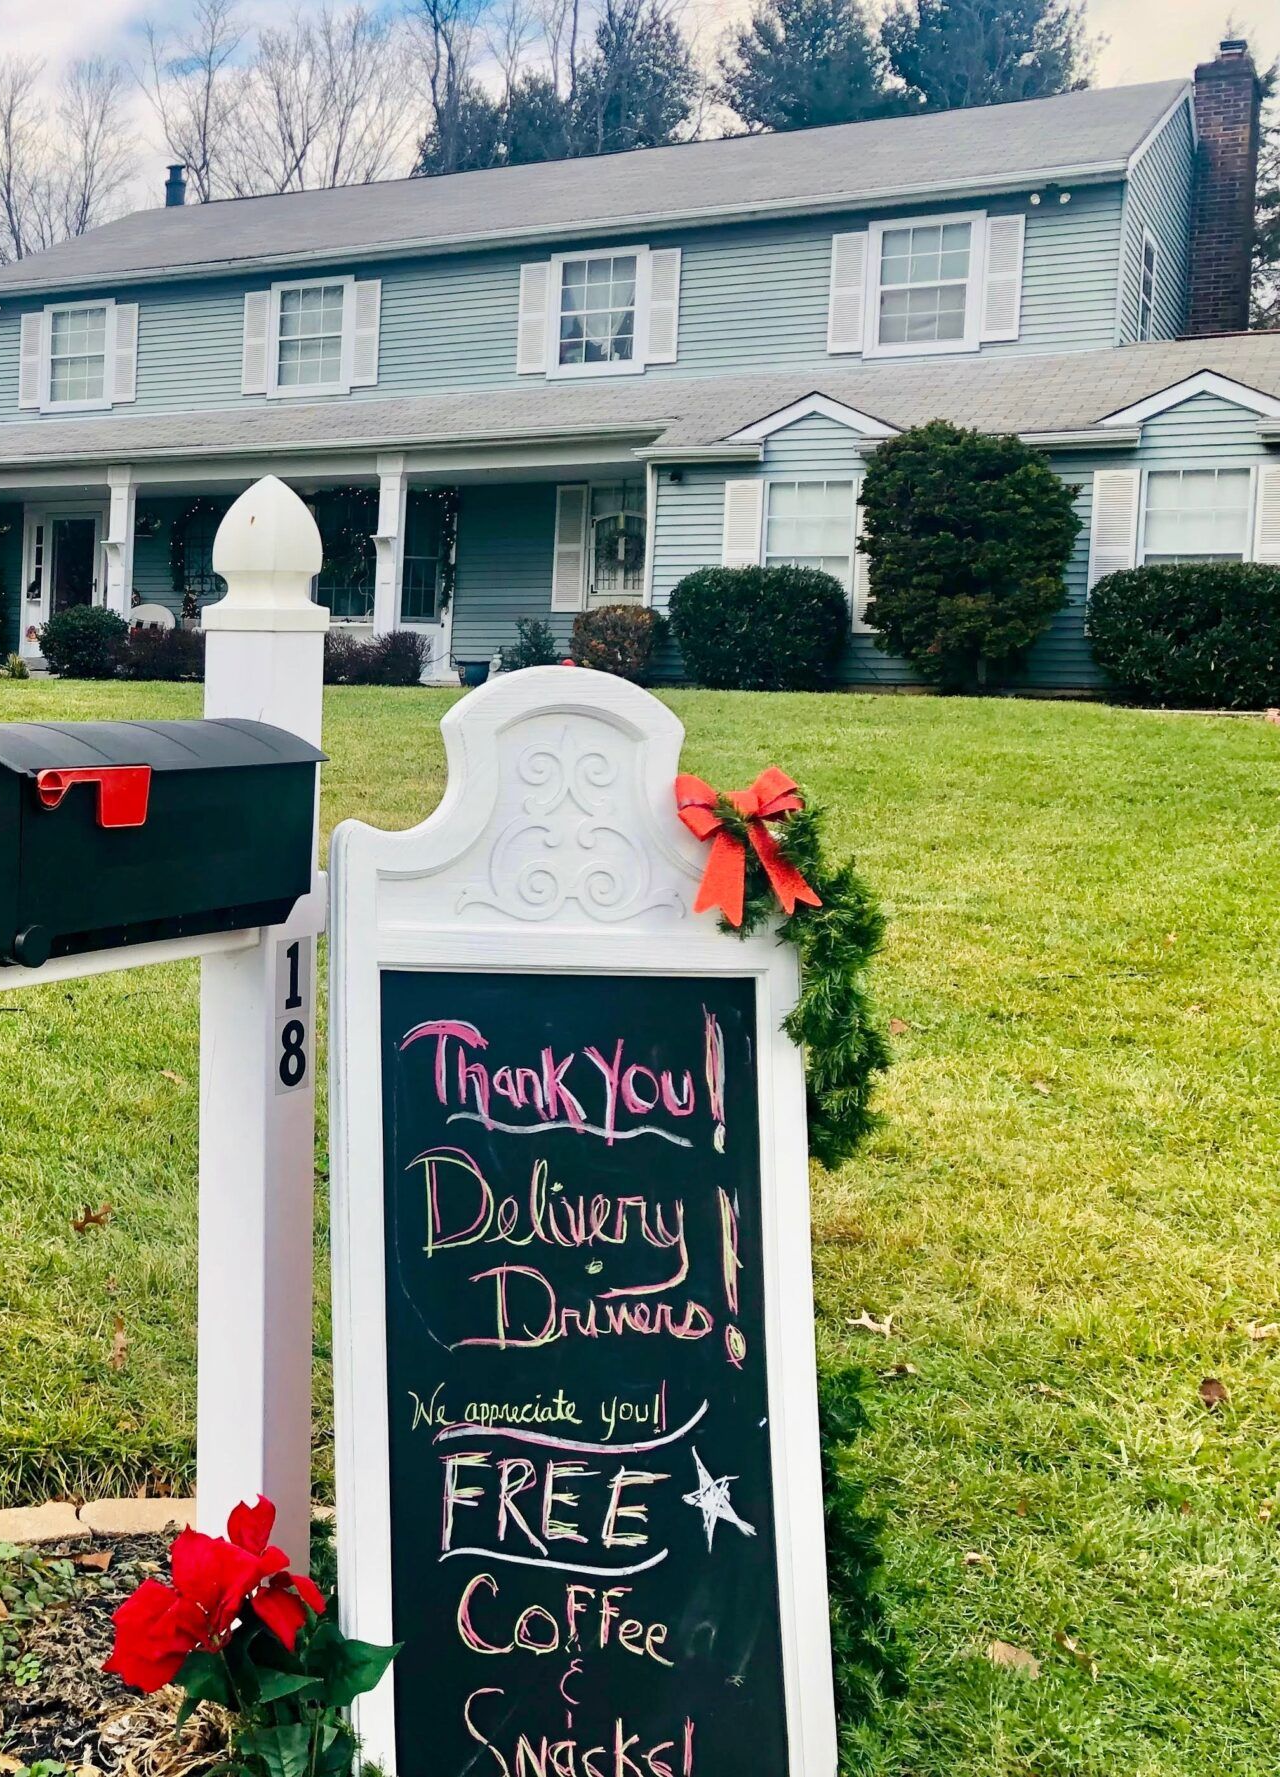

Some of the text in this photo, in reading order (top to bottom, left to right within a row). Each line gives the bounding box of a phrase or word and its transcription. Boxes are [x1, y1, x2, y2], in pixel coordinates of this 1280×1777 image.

[278, 941, 307, 1088] 18
[408, 1382, 456, 1430] We
[464, 1389, 582, 1428] appreciate
[439, 1452, 671, 1556] FREE
